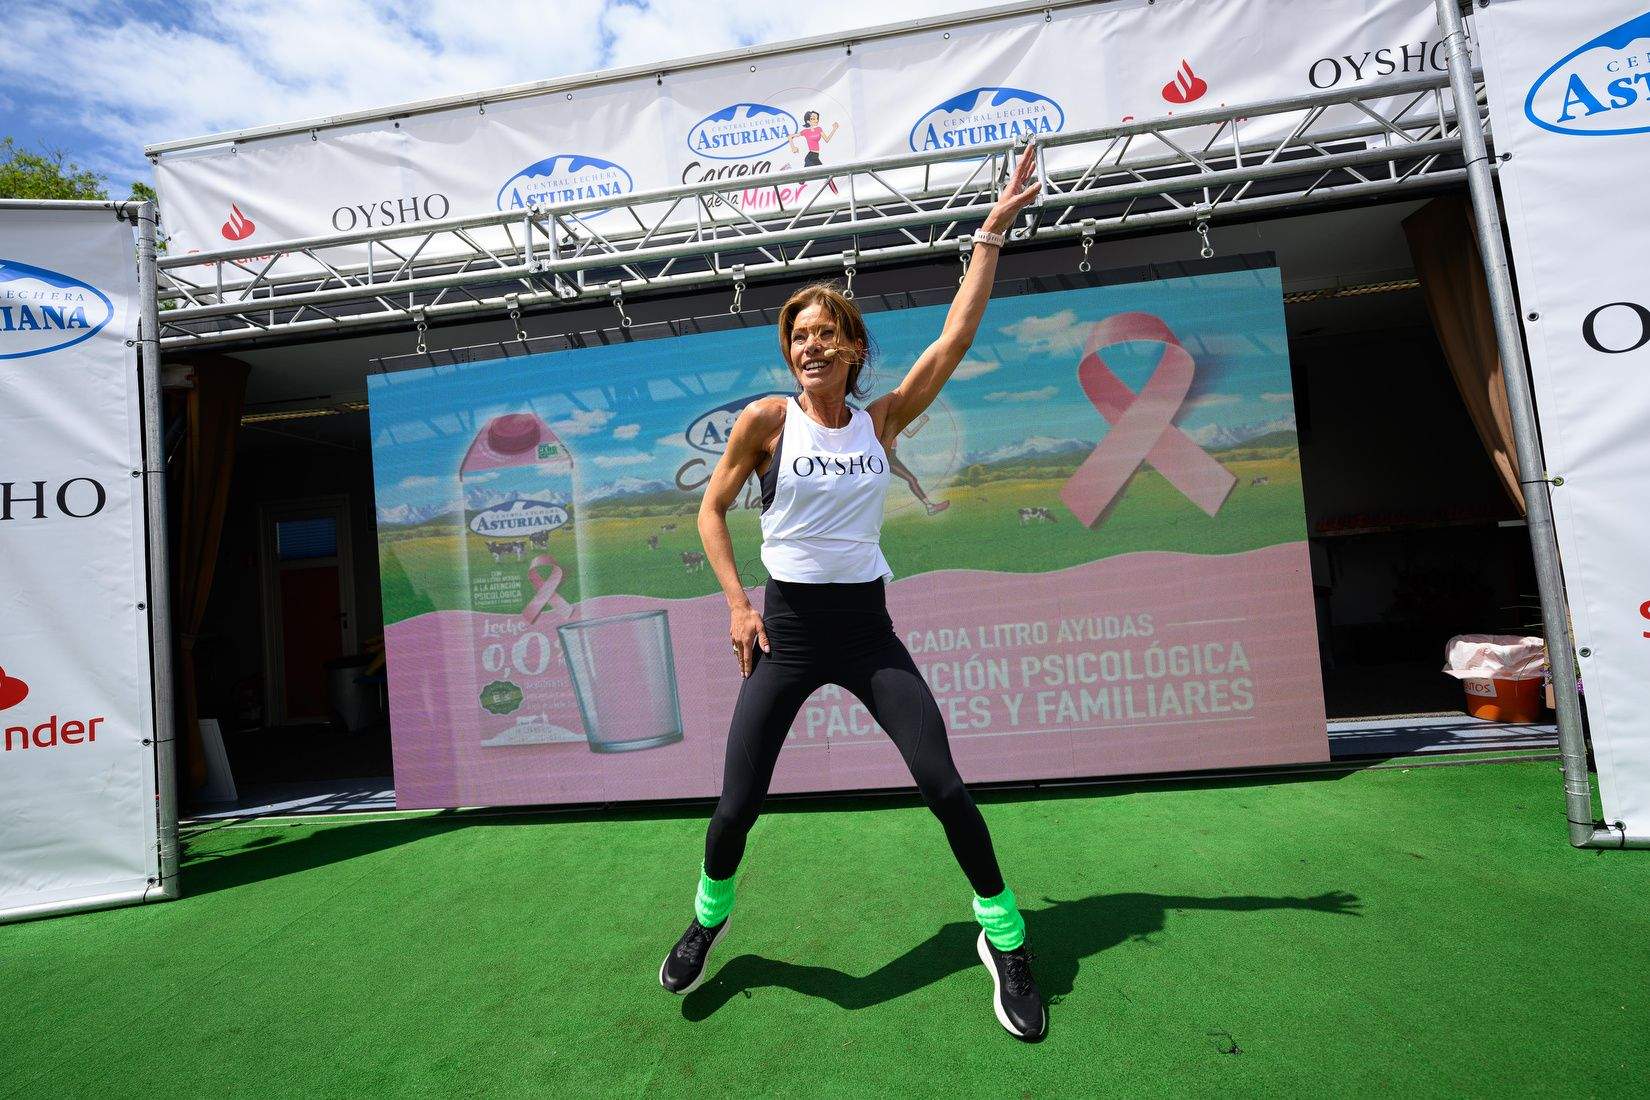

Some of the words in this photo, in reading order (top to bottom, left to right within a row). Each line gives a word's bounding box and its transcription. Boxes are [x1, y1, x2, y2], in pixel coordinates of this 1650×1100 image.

[1308, 40, 1449, 89] OYSHO
[944, 113, 992, 127] CENTRAL
[997, 105, 1046, 119] LECHERA
[697, 124, 790, 149] ASTURIANA
[923, 116, 1053, 150] ASTURIANA
[510, 181, 622, 210] ASTURIANA
[526, 178, 570, 190] CENTRAL
[332, 193, 449, 231] OYSHO
[0, 290, 84, 301] ECHERA
[0, 304, 90, 331] IANA
[792, 455, 884, 478] OYSHO
[477, 514, 562, 531] ASTURIANA
[907, 627, 972, 653] CADA
[977, 621, 1048, 649] LITRO
[1056, 612, 1154, 643] AYUDAS
[1021, 640, 1250, 688] PSICOLÓGICA
[1001, 692, 1024, 727] Y
[1036, 676, 1255, 725] FAMILIARES
